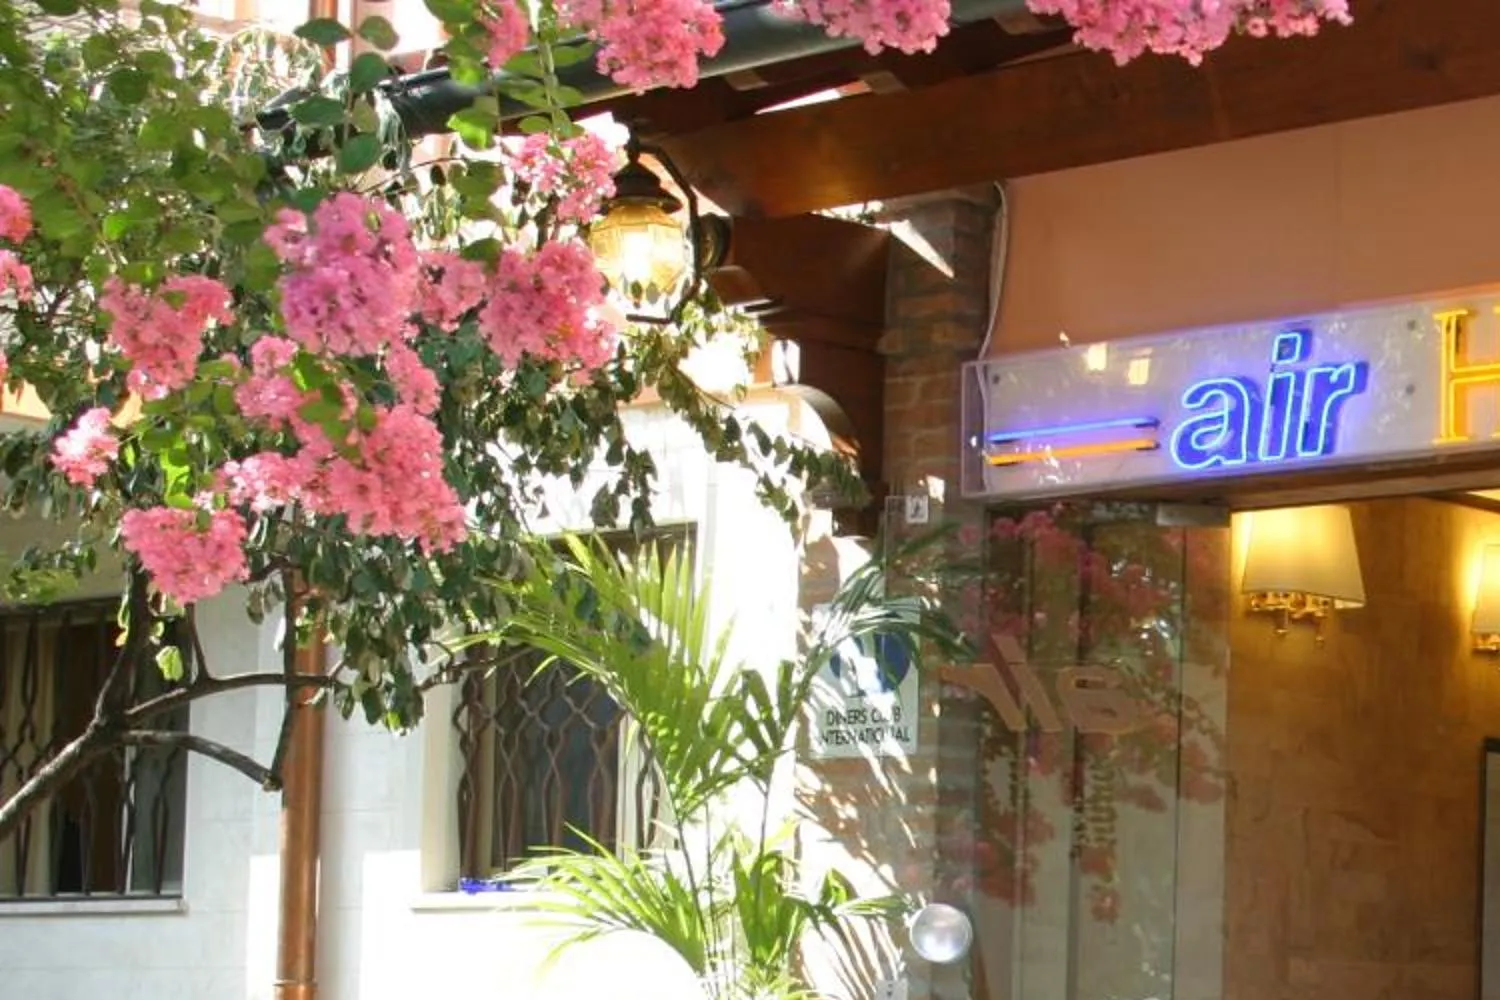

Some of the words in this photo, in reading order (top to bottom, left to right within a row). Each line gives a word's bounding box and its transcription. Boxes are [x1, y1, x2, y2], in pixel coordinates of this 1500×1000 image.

[1171, 325, 1366, 469] air
[826, 708, 867, 726] DINERS
[871, 706, 901, 724] CB
